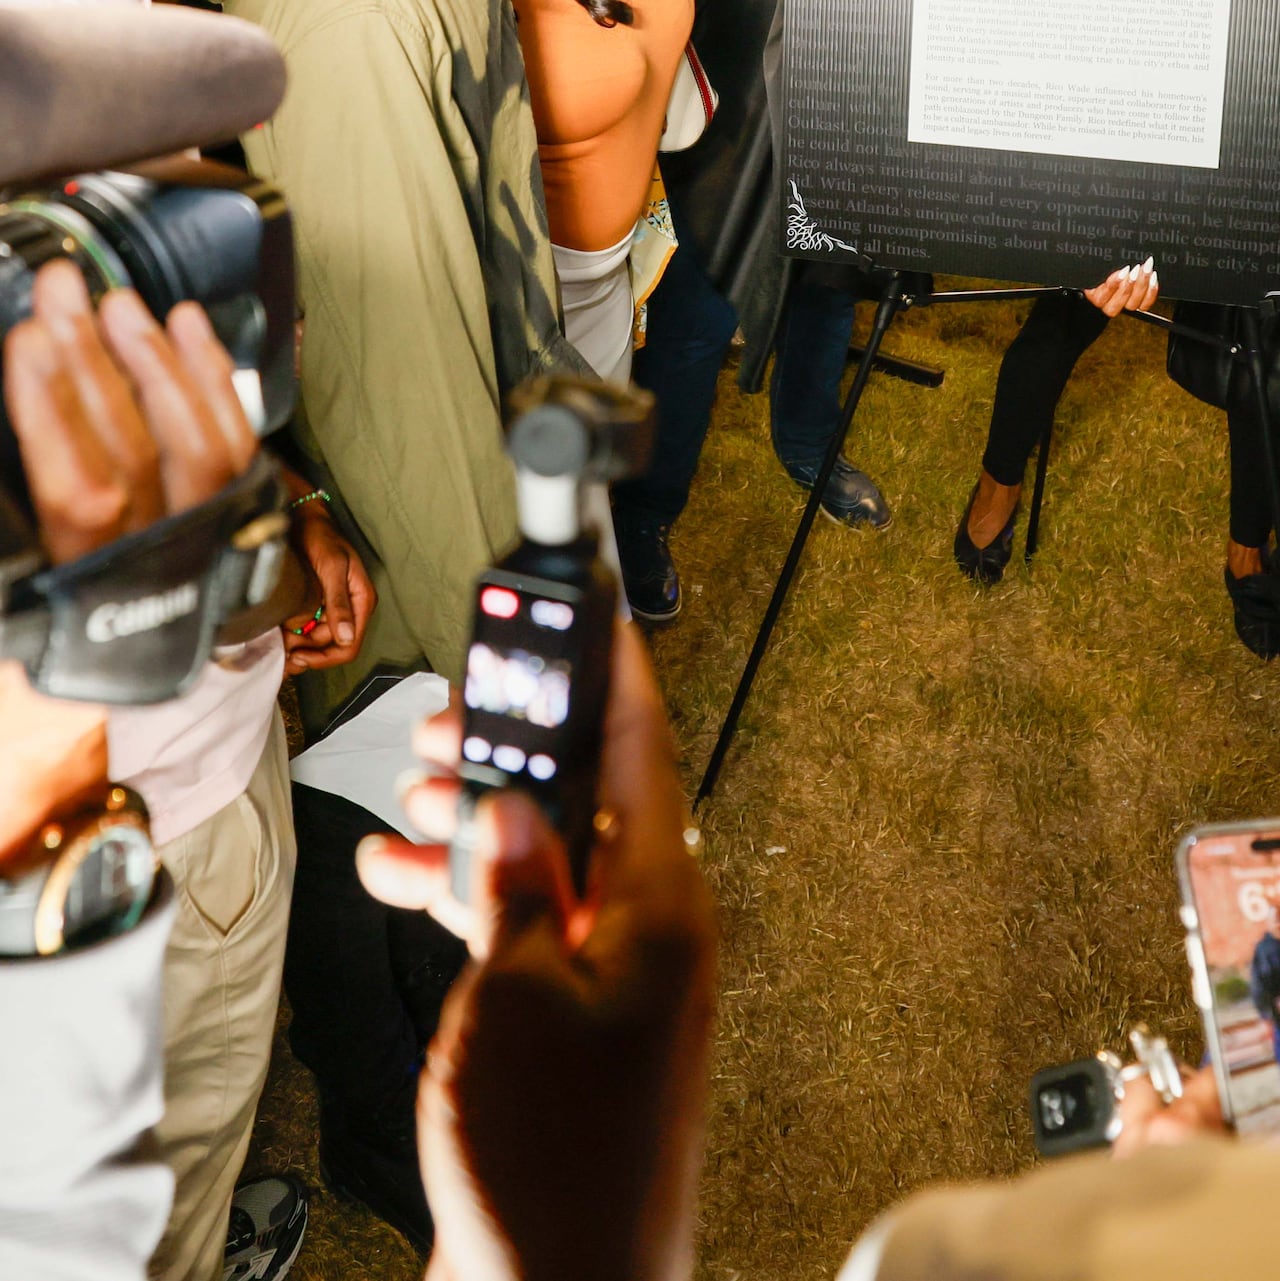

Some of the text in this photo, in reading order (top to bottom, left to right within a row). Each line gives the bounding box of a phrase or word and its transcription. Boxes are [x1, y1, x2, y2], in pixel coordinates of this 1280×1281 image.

[924, 104, 940, 112] path
[944, 105, 989, 115] emblazoned
[1003, 109, 1015, 117] the
[1018, 110, 1053, 121] Dungeon
[1088, 116, 1105, 124] Rico
[1108, 118, 1145, 128] redefined
[1149, 121, 1168, 130] what
[1179, 125, 1205, 133] meant
[941, 95, 985, 105] generations
[1000, 100, 1023, 108] artists
[1044, 103, 1083, 112] producers
[1088, 106, 1104, 114] who
[1107, 108, 1125, 116] have
[1129, 110, 1149, 118] come
[1164, 112, 1190, 121] follow
[1193, 114, 1206, 122] the
[788, 134, 805, 148] he
[810, 137, 850, 152] could
[856, 142, 879, 155] not
[950, 115, 979, 124] cultural
[1034, 122, 1056, 130] While
[1078, 126, 1105, 135] missed
[1133, 130, 1165, 142] physical
[788, 154, 820, 170] Rico
[826, 158, 874, 175] always
[881, 163, 963, 183] intentional
[969, 171, 1012, 187] about
[1020, 176, 1080, 196] keeping
[1088, 183, 1145, 200] Atlanta
[1152, 190, 1168, 202] at
[1175, 190, 1200, 205] the
[1207, 192, 1280, 212] forefront
[820, 177, 856, 192] With
[861, 182, 901, 198] every
[907, 184, 960, 201] release
[965, 192, 994, 205] and
[1000, 197, 1041, 212] every
[1047, 202, 1143, 223] opportunity
[1148, 211, 1196, 227] given,
[1203, 212, 1223, 227] he
[846, 200, 911, 217] Atlanta's
[916, 208, 968, 224] unique
[972, 212, 1028, 229] culture
[1032, 218, 1061, 233] and
[1066, 220, 1106, 239] lingo
[1111, 224, 1133, 239] for
[1139, 227, 1189, 245] public
[863, 239, 931, 258] all times.
[868, 223, 997, 248] uncompromising
[1004, 234, 1048, 250] about
[1056, 240, 1113, 261] staying
[1161, 252, 1178, 264] to
[1185, 251, 1209, 267] his
[1216, 256, 1259, 274] city's
[87, 581, 199, 644] Canon
